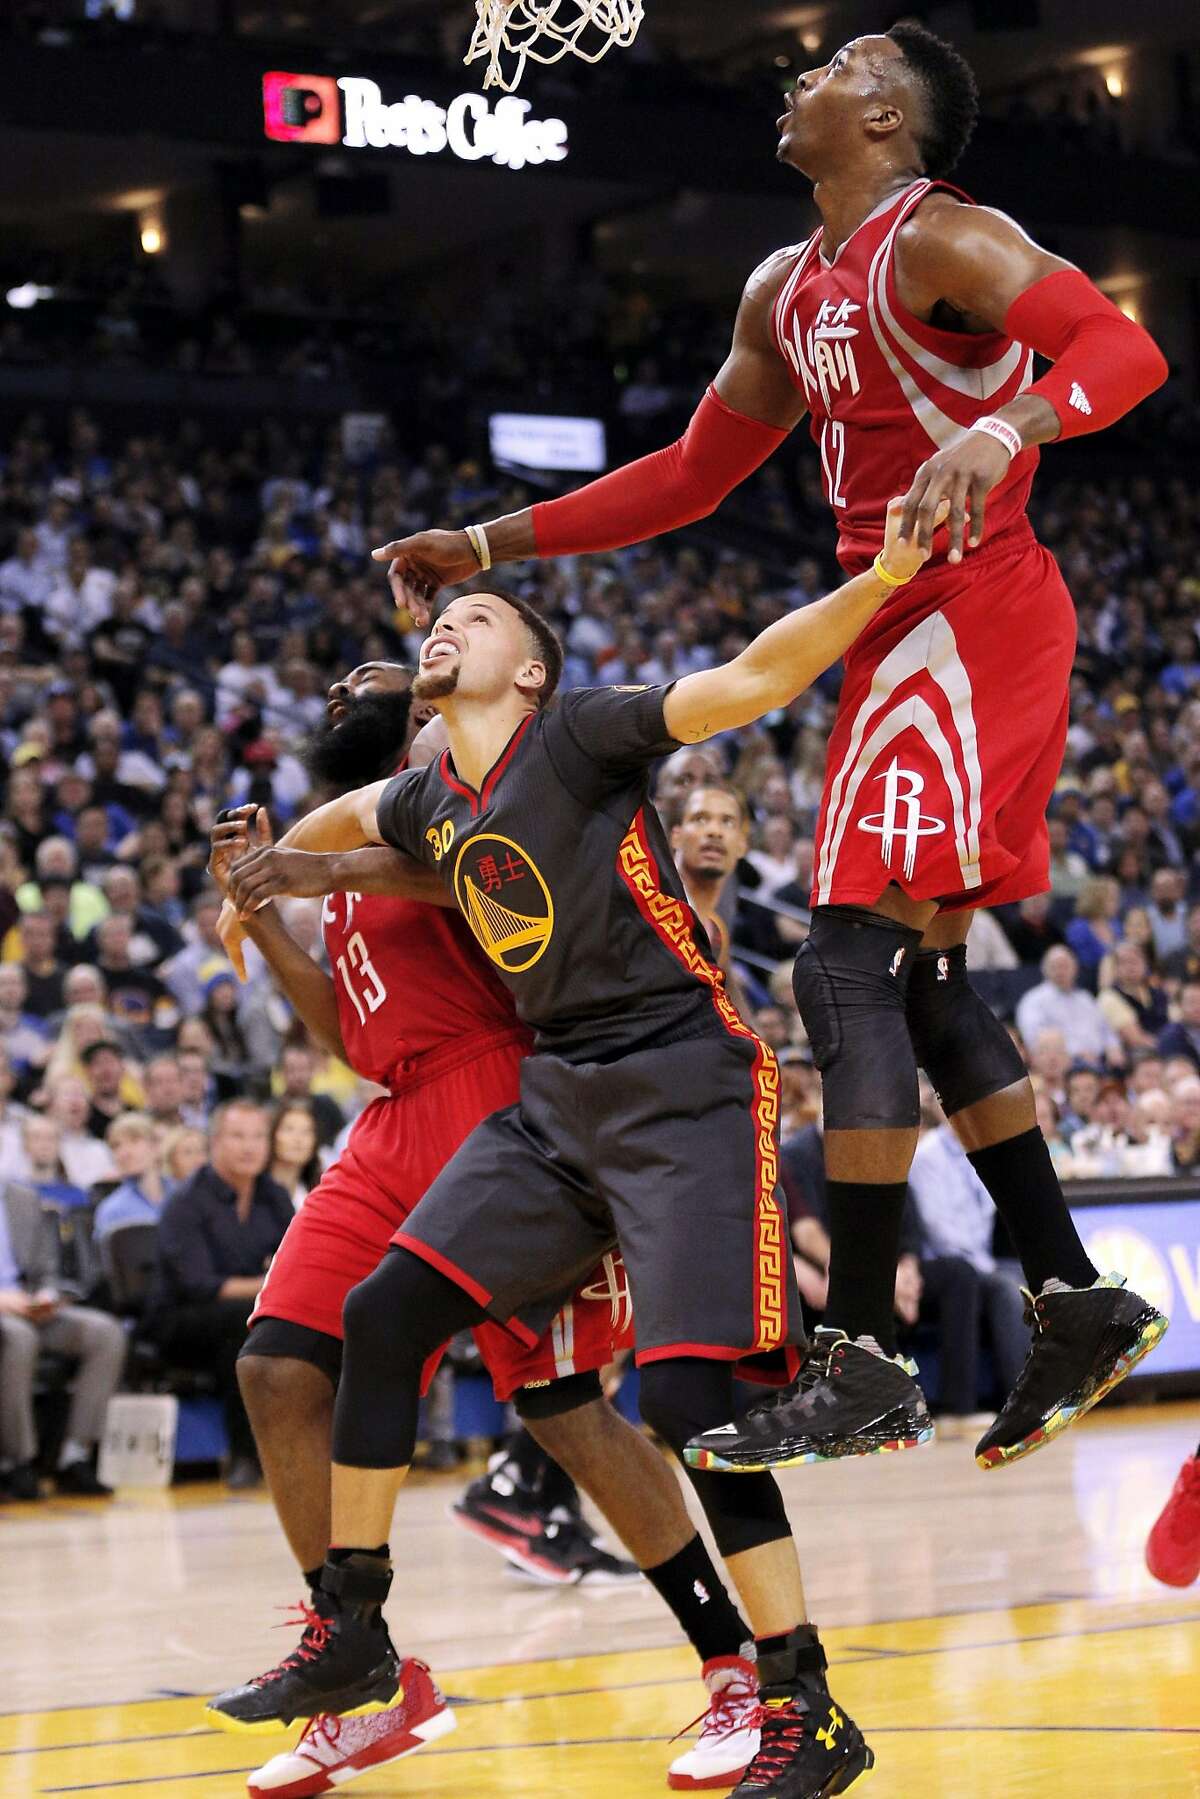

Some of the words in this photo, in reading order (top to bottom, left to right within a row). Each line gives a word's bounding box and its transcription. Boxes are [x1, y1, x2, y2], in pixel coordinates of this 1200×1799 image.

[820, 418, 847, 508] 12
[425, 819, 455, 861] 30
[475, 850, 528, 895] 勇士
[336, 931, 387, 1027] 13
